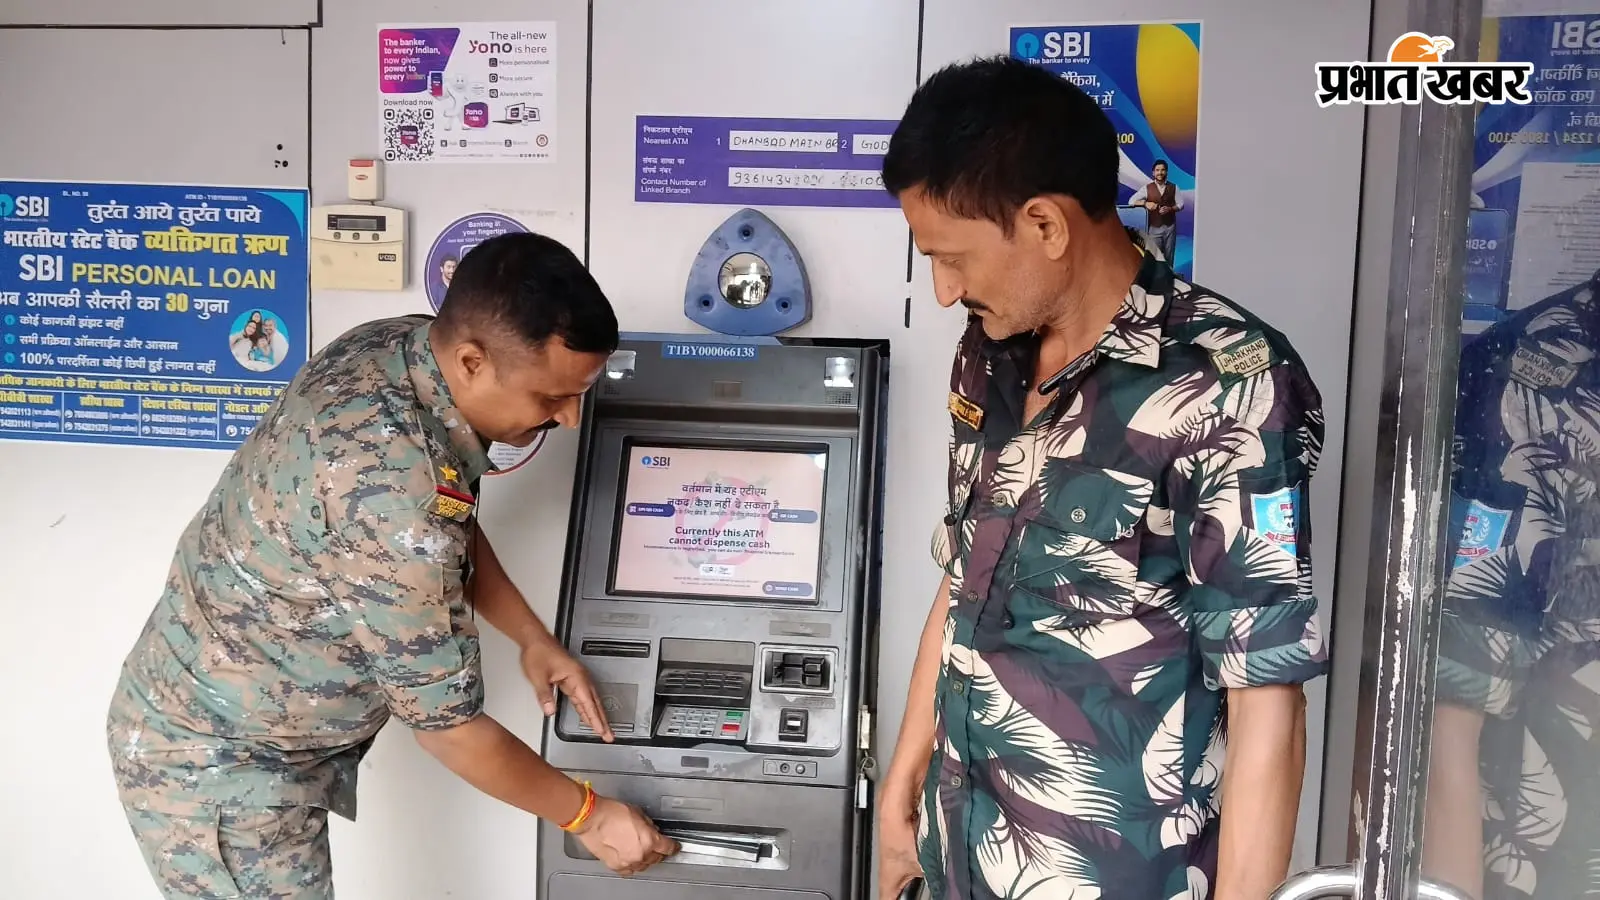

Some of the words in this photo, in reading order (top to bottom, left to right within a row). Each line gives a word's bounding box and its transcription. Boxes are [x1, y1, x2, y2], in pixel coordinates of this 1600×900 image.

[490, 31, 509, 40] The
[511, 31, 547, 40] all-new
[384, 38, 398, 46] The
[400, 38, 425, 46] banker
[1044, 32, 1091, 58] SBI
[416, 46, 440, 55] Indian,
[525, 45, 547, 53] here
[401, 57, 420, 65] gives
[384, 66, 407, 74] power
[384, 74, 404, 82] every
[643, 137, 671, 145] Nearest
[716, 137, 721, 146] 1
[790, 136, 822, 149] MAIN
[841, 139, 848, 149] 2
[641, 178, 668, 186] Contact
[669, 178, 698, 187] Number
[699, 179, 706, 187] of
[641, 186, 664, 194] Linked
[665, 187, 691, 195] Branch
[15, 196, 50, 217] SBI
[87, 199, 129, 224] तुरंत
[133, 202, 174, 220] आये
[178, 202, 221, 227] तुरंत
[225, 205, 262, 224] पाये
[468, 221, 493, 229] Banking
[4, 227, 68, 248] भारतीय
[70, 228, 103, 249] स्टेट
[104, 229, 139, 250] बैंक
[142, 226, 239, 255] व्यक्तिगत
[242, 234, 290, 256] ऋण
[19, 254, 64, 281] SBI
[72, 263, 202, 287] PERSONAL
[209, 268, 276, 290] LOAN
[26, 288, 80, 308] आपकी
[85, 289, 132, 310] सैलरी
[137, 296, 160, 311] का
[165, 292, 189, 312] 30
[193, 298, 229, 320] गुना
[19, 313, 39, 327] कोई
[42, 315, 76, 327] कागजी
[105, 316, 124, 330] नहीं
[41, 333, 71, 346] प्रक्रिया
[124, 337, 142, 349] और
[145, 340, 179, 351] आसान
[667, 344, 755, 358] T1BY000066138
[1223, 339, 1266, 367] JHARKHAND
[20, 352, 54, 365] 100%
[102, 356, 122, 369] कोई
[165, 361, 194, 371] लागत
[196, 360, 216, 373] नहीं
[1234, 353, 1263, 372] POLICE
[652, 456, 670, 467] SBI
[682, 482, 712, 494] वर्तमान
[723, 485, 737, 496] यह
[740, 485, 767, 497] एटीएम
[714, 498, 731, 510] नहीं
[744, 501, 771, 510] सकता
[675, 526, 721, 538] Currently
[723, 529, 740, 537] this
[742, 530, 764, 538] ATM
[669, 536, 702, 545] cannot
[704, 537, 747, 548] dispense
[748, 540, 770, 548] cash
